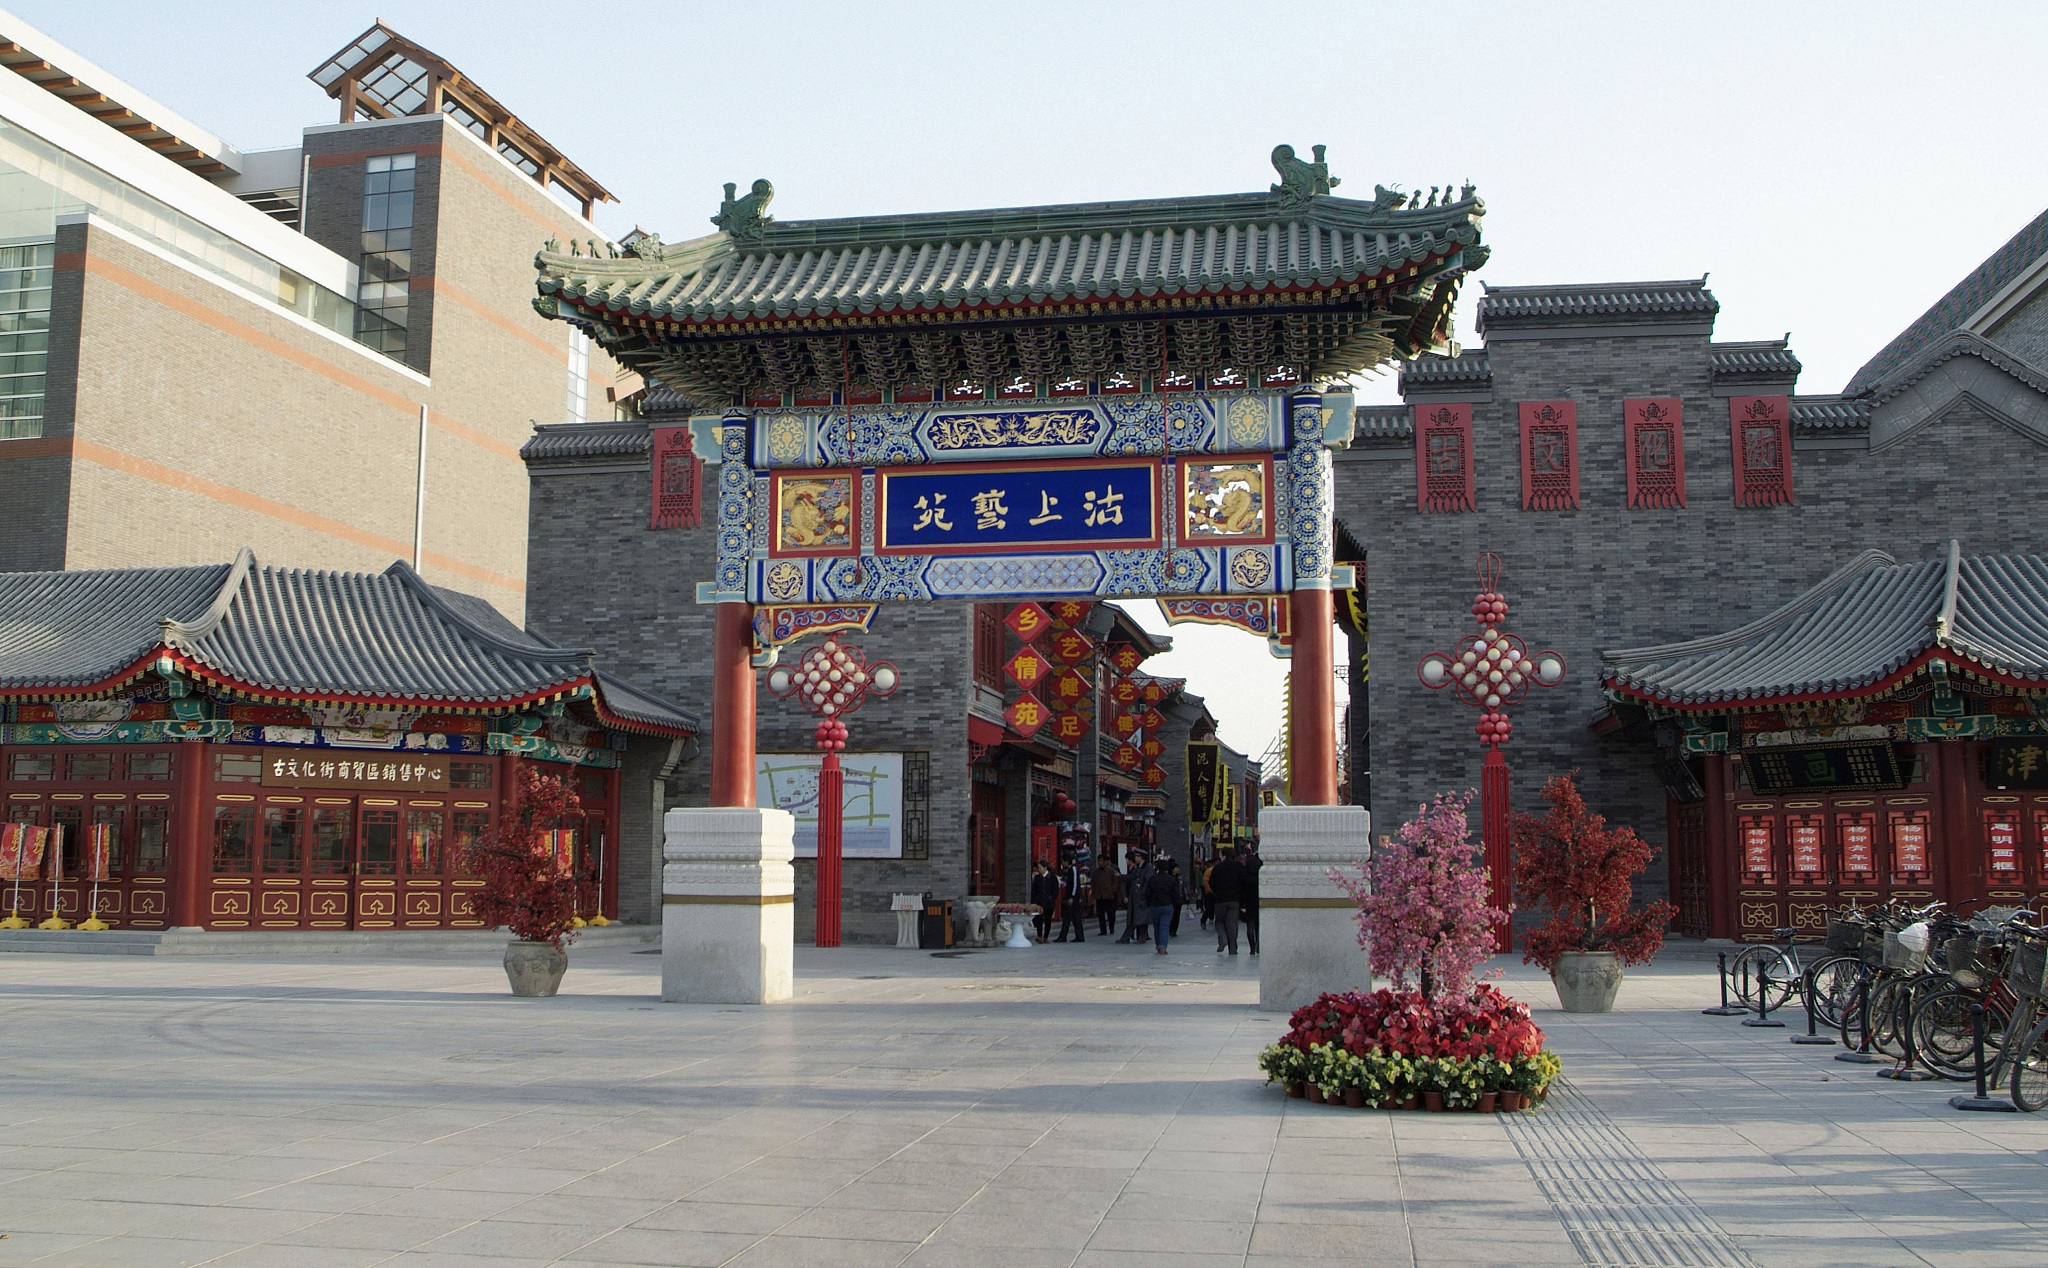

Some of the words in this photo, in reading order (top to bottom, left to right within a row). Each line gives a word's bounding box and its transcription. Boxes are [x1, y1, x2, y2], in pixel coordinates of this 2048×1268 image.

[1431, 434, 1459, 473] 古
[1537, 433, 1564, 471] 文
[1640, 431, 1670, 469] 化
[1746, 429, 1775, 467] 街
[1014, 607, 1039, 726] 乡情苑
[1117, 651, 1135, 765] 茶艺健足
[273, 758, 442, 782] 古文化街商貿區銷售中心
